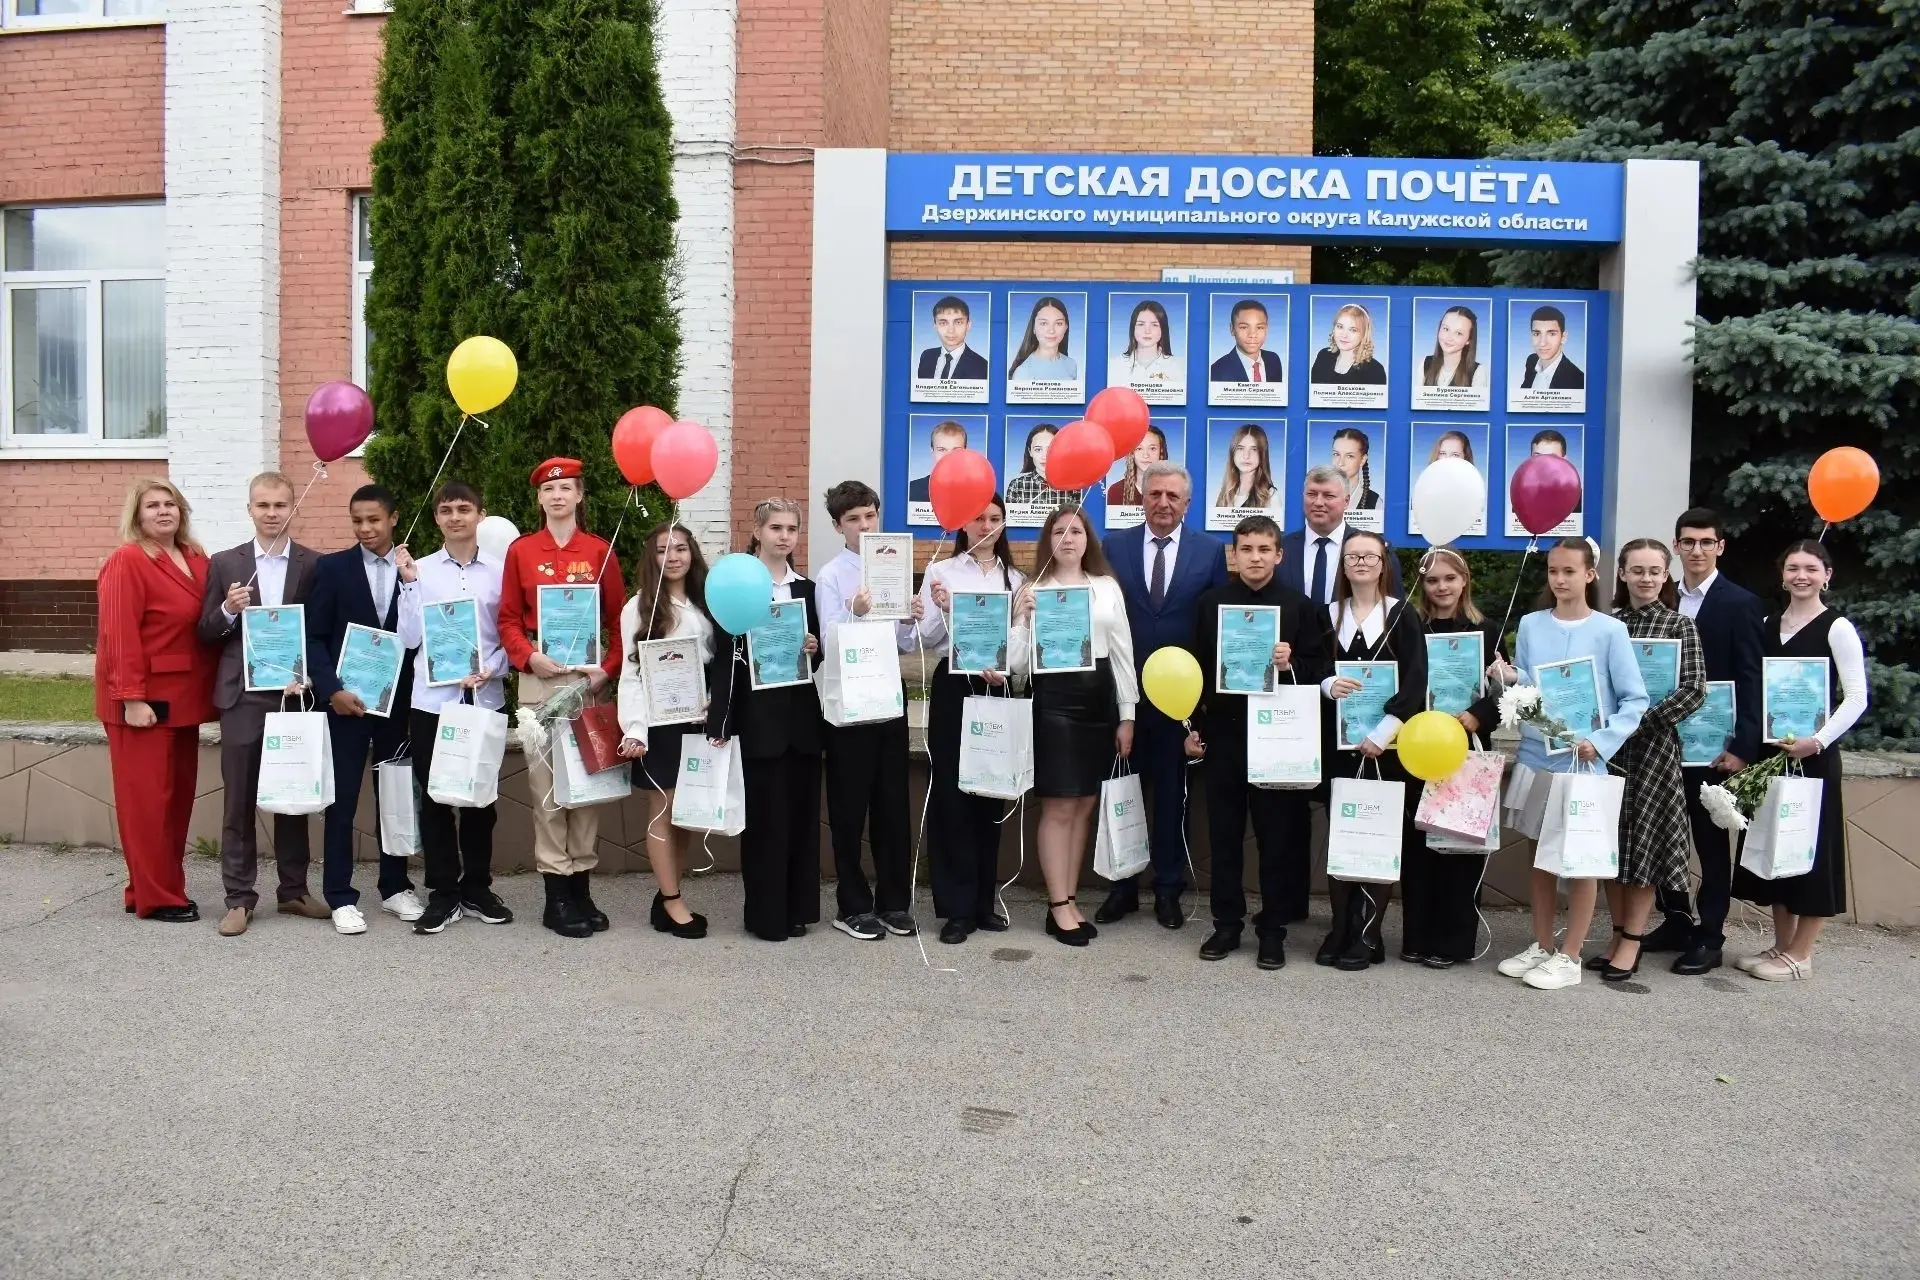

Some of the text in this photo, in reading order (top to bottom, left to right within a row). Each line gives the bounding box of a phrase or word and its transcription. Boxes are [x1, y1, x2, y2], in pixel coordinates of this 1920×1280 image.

[948, 164, 1561, 205] ДЕТСКАЯ ДОСКА ПОЧЁТА
[921, 204, 1588, 231] Дзержинского муниципального округа Калужской области
